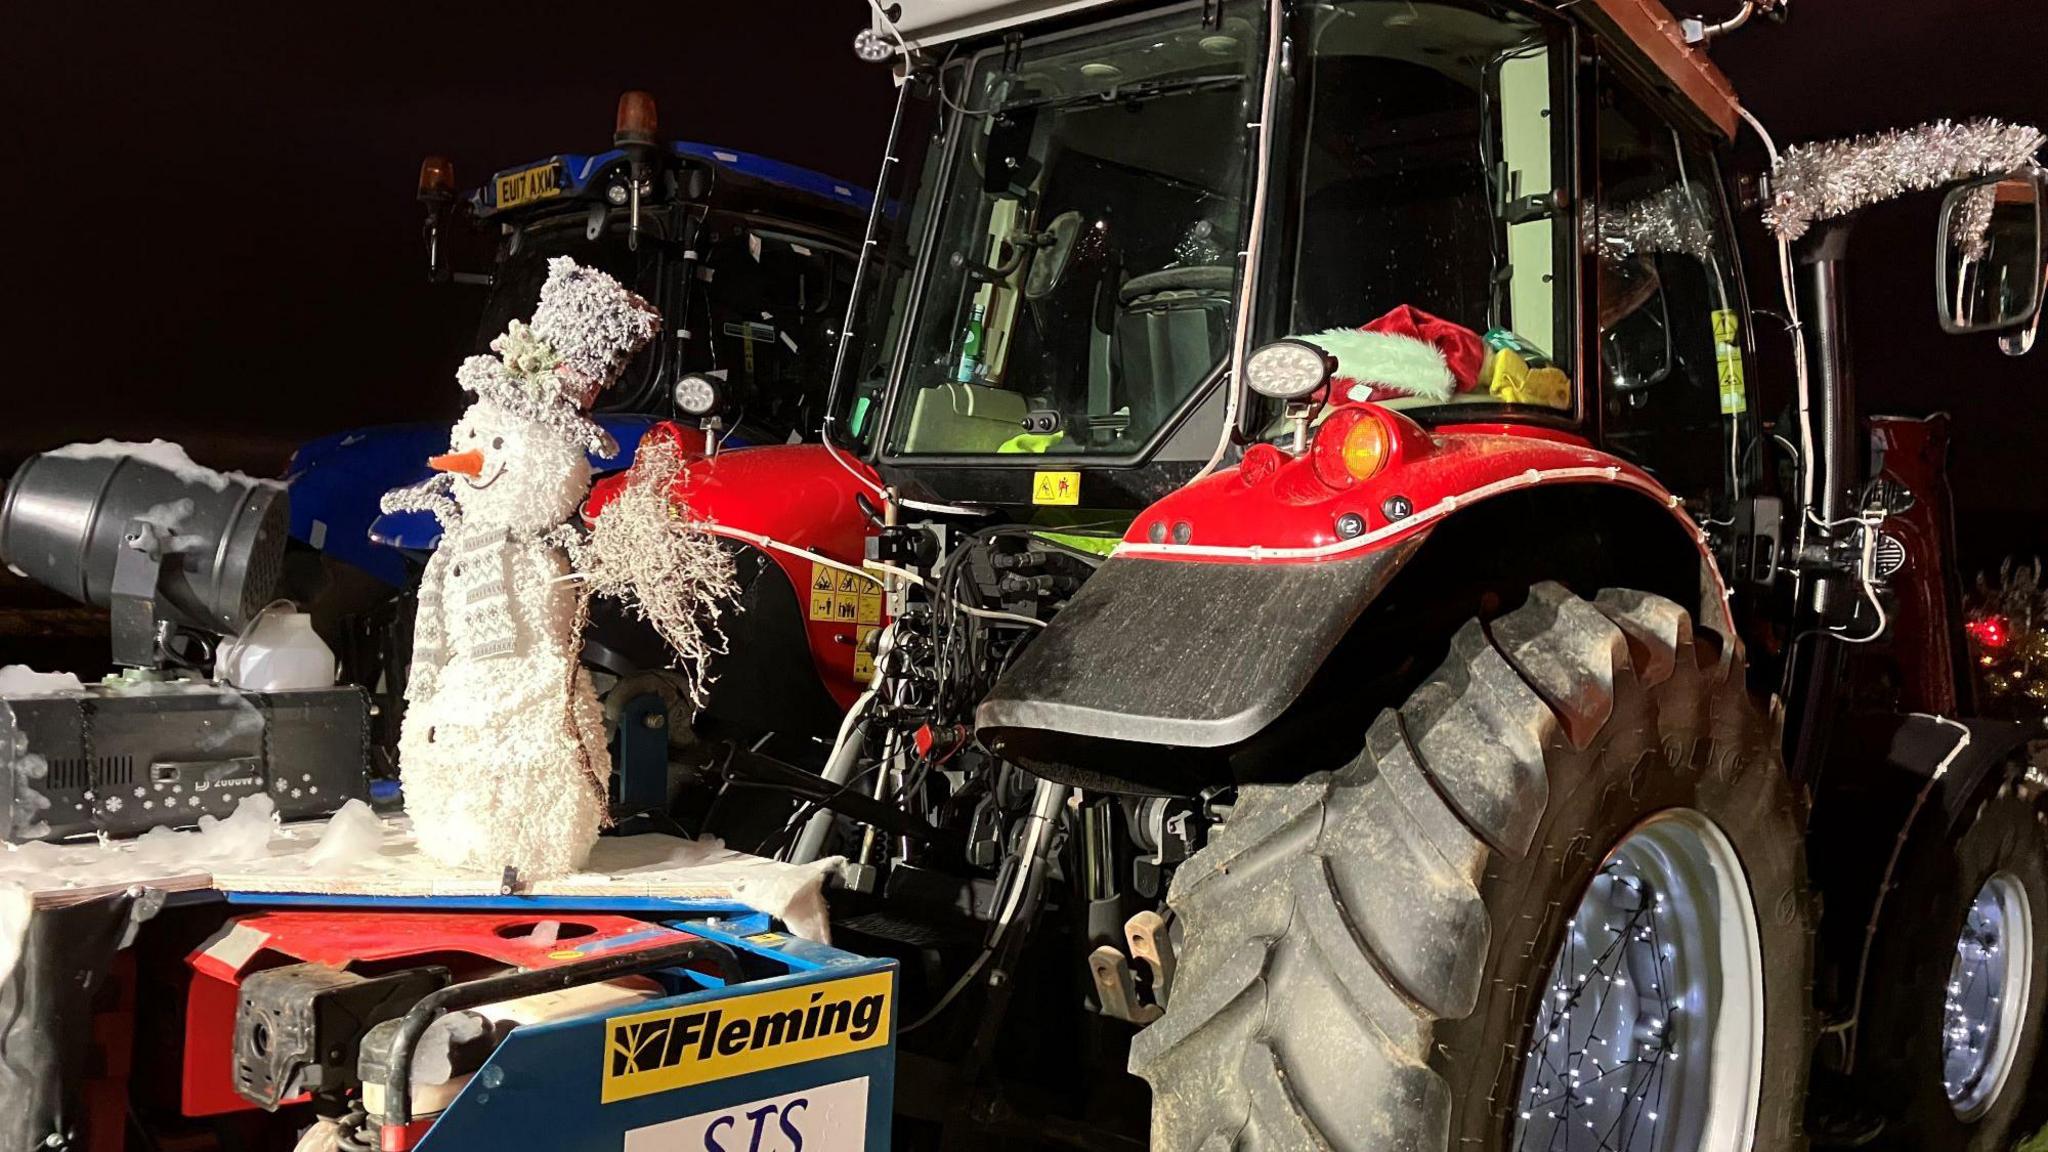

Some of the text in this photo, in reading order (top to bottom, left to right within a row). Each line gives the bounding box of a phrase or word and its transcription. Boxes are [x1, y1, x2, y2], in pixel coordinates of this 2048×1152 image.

[502, 174, 526, 202] EU17
[662, 991, 885, 1068] Fleming
[704, 1098, 809, 1152] STS
